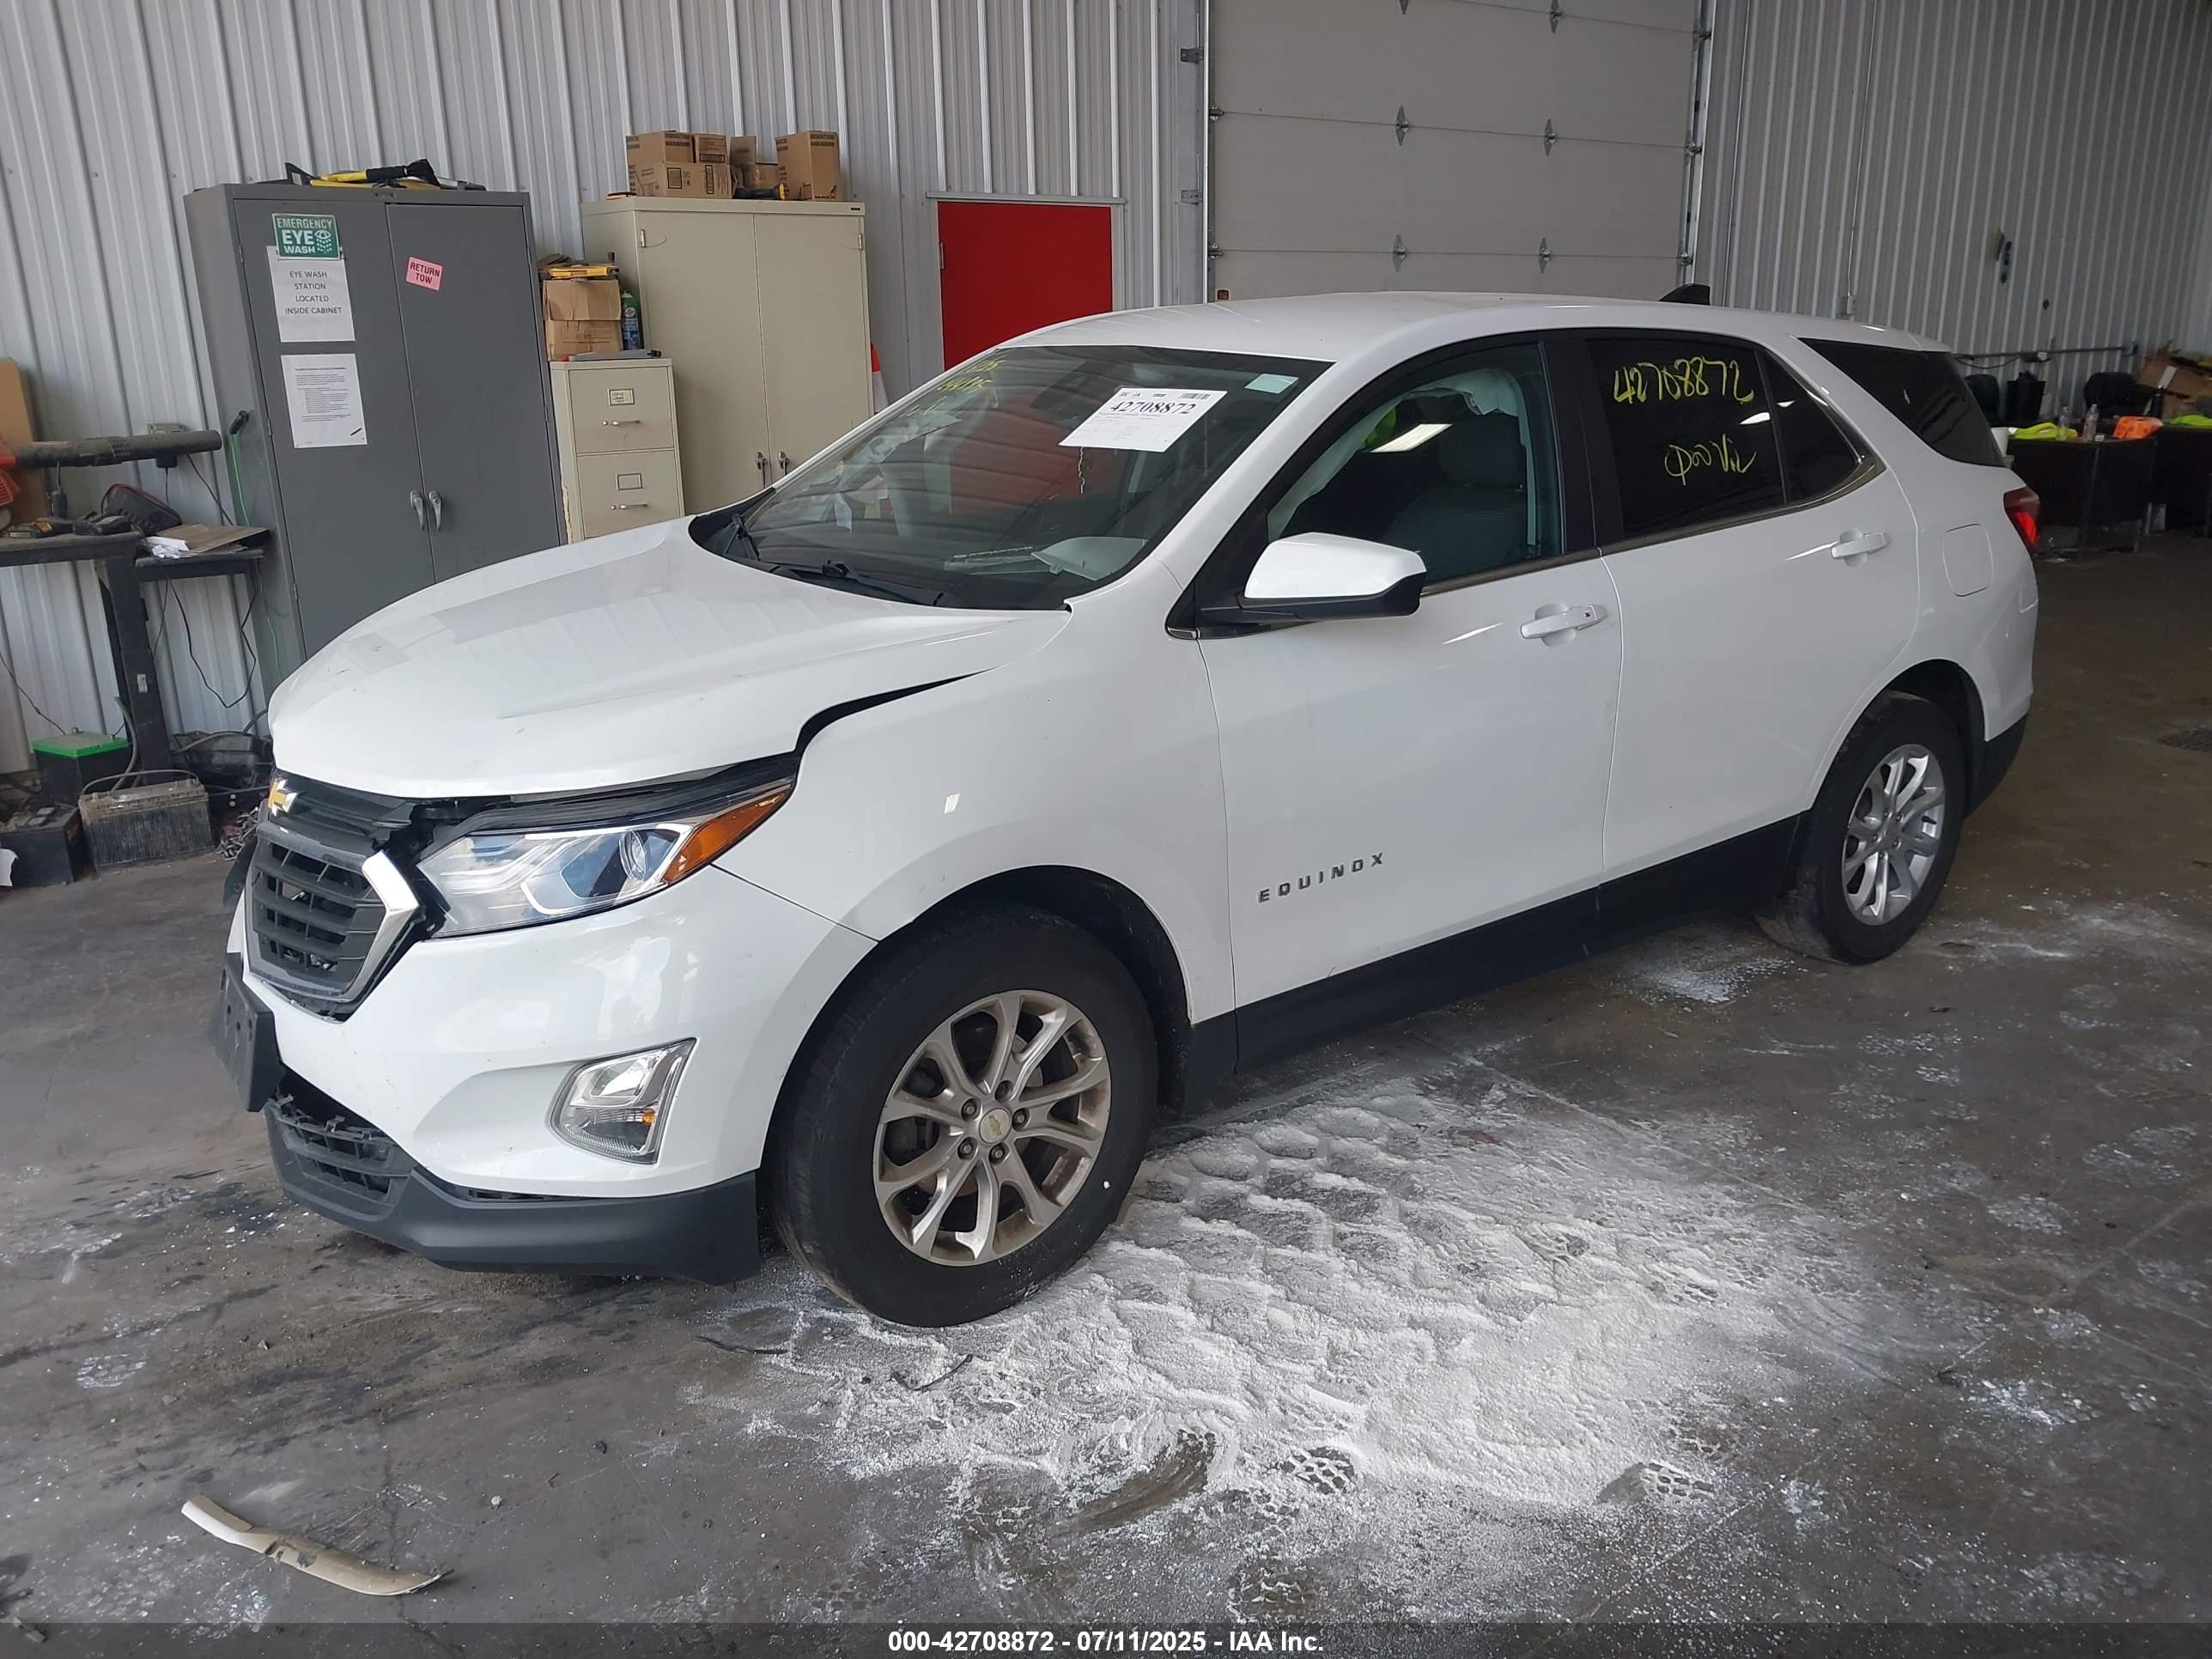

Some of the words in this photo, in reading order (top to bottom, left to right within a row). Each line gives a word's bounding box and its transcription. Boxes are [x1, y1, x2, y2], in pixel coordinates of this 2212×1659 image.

[276, 218, 332, 229] EMERGENCY
[282, 229, 314, 245] EYE
[283, 246, 315, 254] WASH
[410, 262, 441, 277] RETURN
[416, 272, 433, 284] TOW
[1613, 356, 1755, 405] 42708872
[1110, 401, 1197, 416] 42708872
[1258, 852, 1383, 903] EQUINOX
